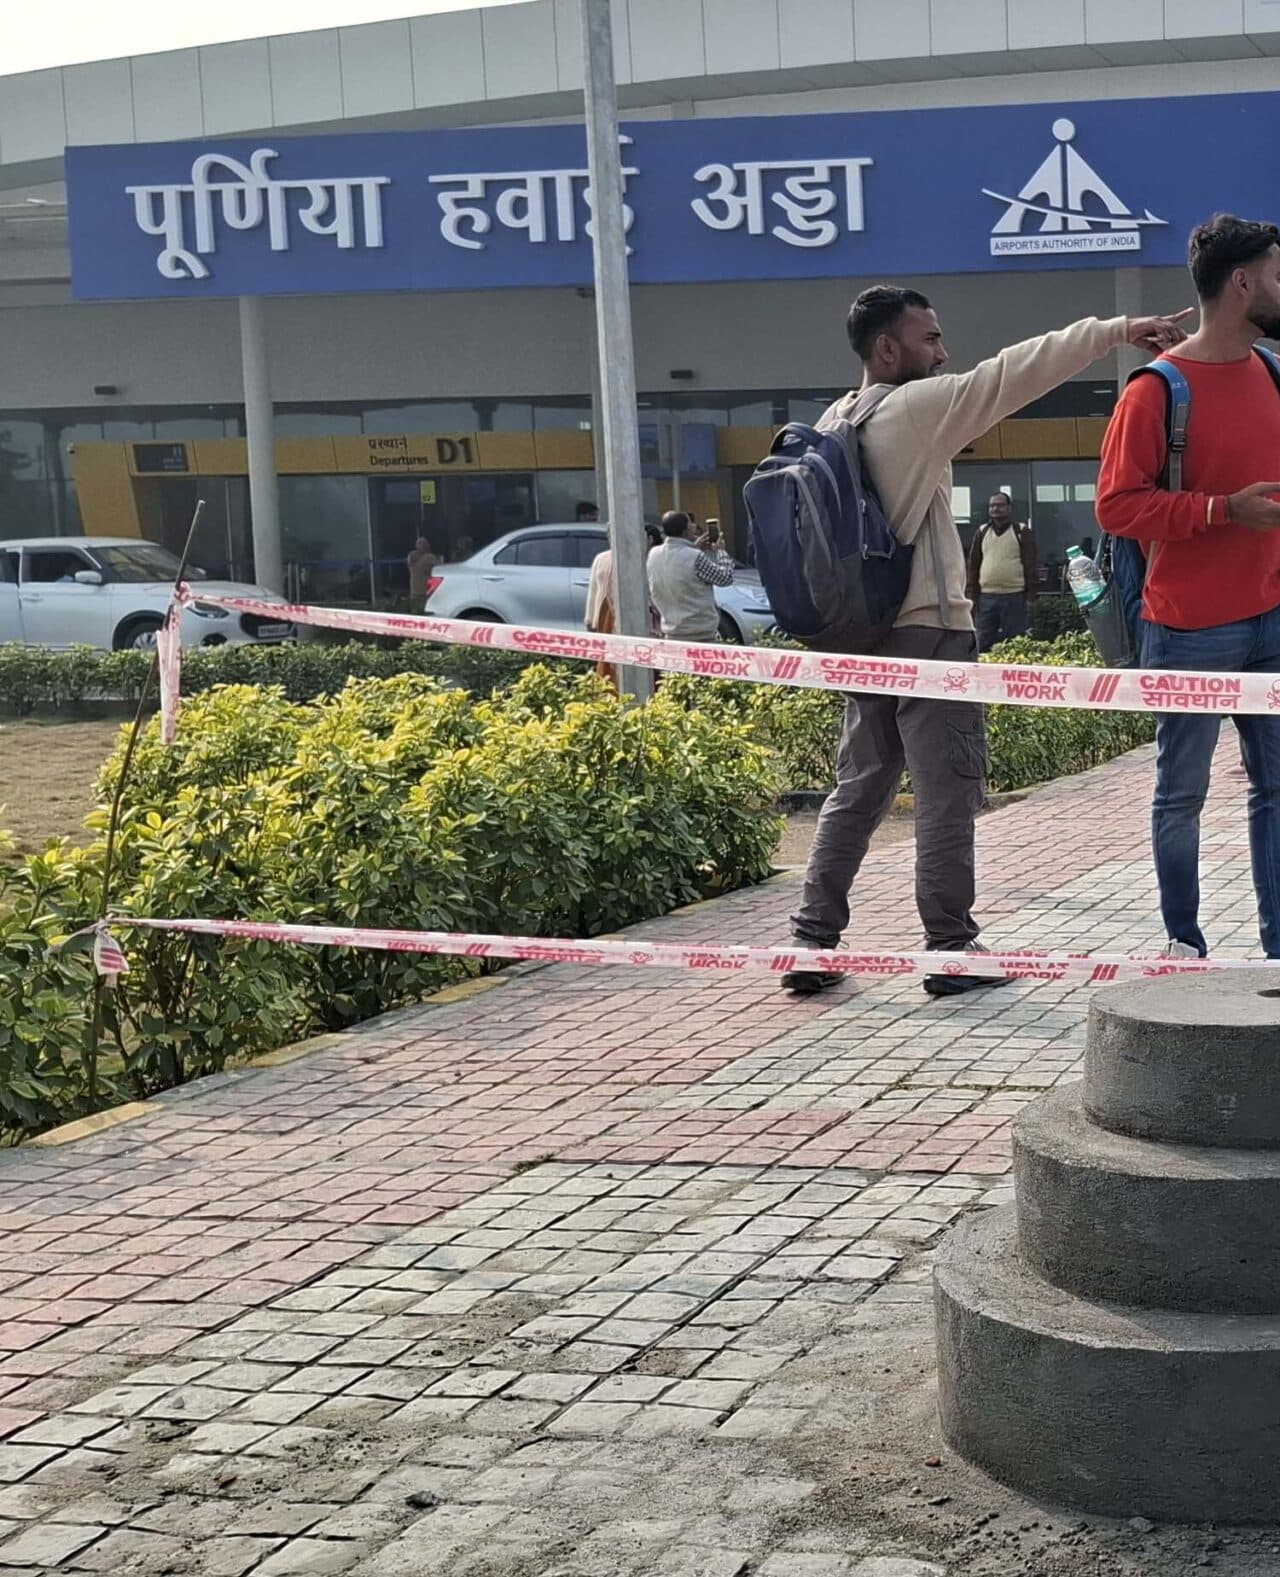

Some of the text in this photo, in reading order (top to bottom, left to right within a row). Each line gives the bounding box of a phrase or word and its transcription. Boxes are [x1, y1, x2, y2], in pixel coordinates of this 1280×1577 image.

[124, 148, 391, 279] पूर्णिया
[691, 157, 875, 248] अड्डा
[994, 236, 1136, 251] AIRPORTS AUTHORITY OF INDIA
[435, 437, 474, 464] D1
[370, 455, 429, 467] Departures
[512, 630, 607, 651] CAUTION
[686, 647, 755, 661] MEN AT
[693, 660, 751, 676] WORK
[820, 656, 918, 676] CAUTION
[823, 670, 920, 691] सावधान
[1001, 670, 1072, 685] MEN AT
[1139, 674, 1241, 693] CAUTION
[1006, 685, 1067, 702] WORK
[1141, 691, 1242, 710] सावधान
